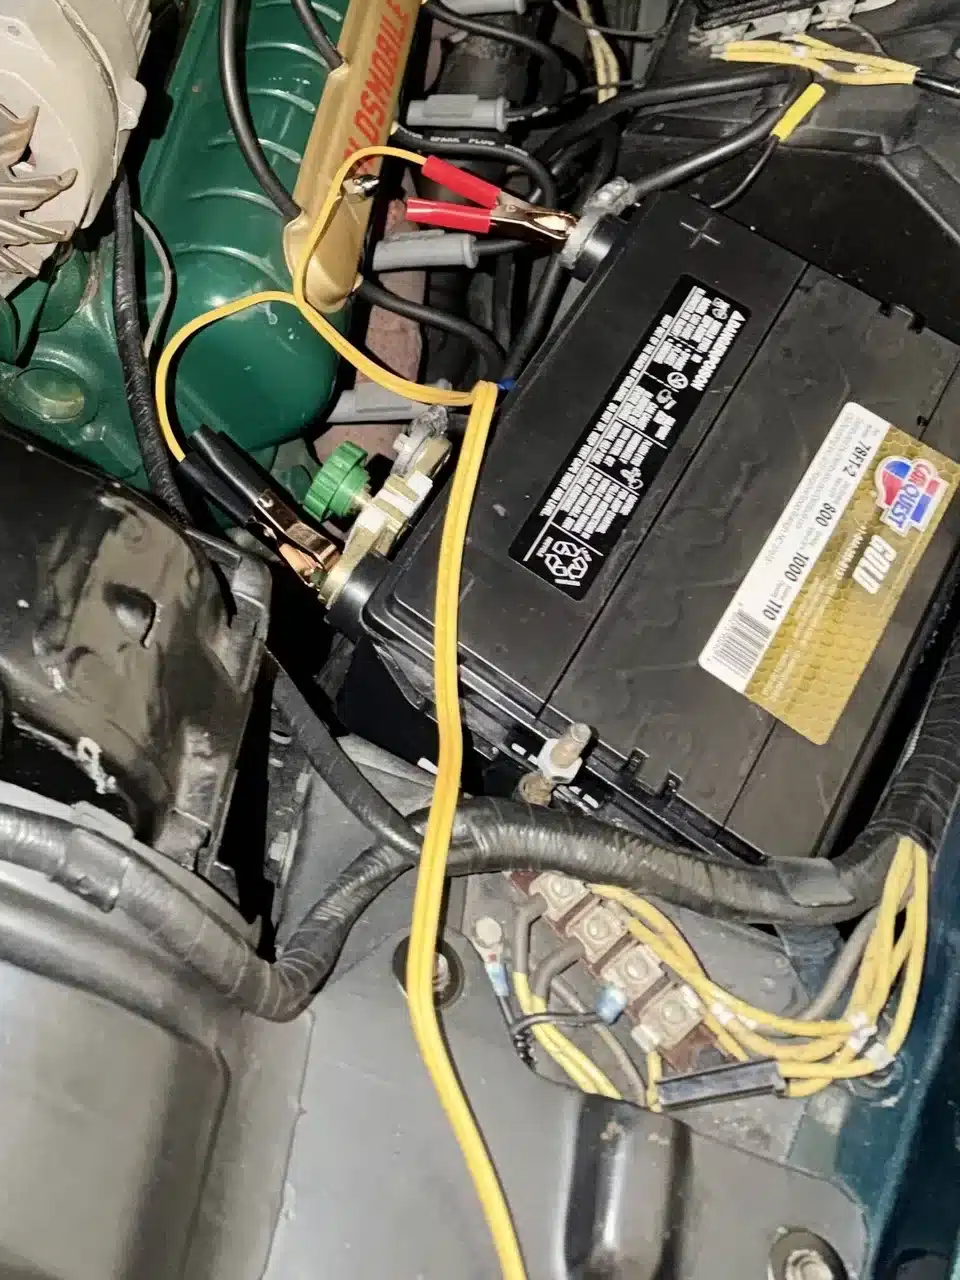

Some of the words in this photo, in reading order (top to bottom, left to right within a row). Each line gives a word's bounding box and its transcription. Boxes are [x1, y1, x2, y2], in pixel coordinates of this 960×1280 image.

[843, 441, 871, 478] 78FT-2
[815, 502, 838, 528] 800
[785, 551, 810, 582] 1000
[762, 598, 783, 621] 110
